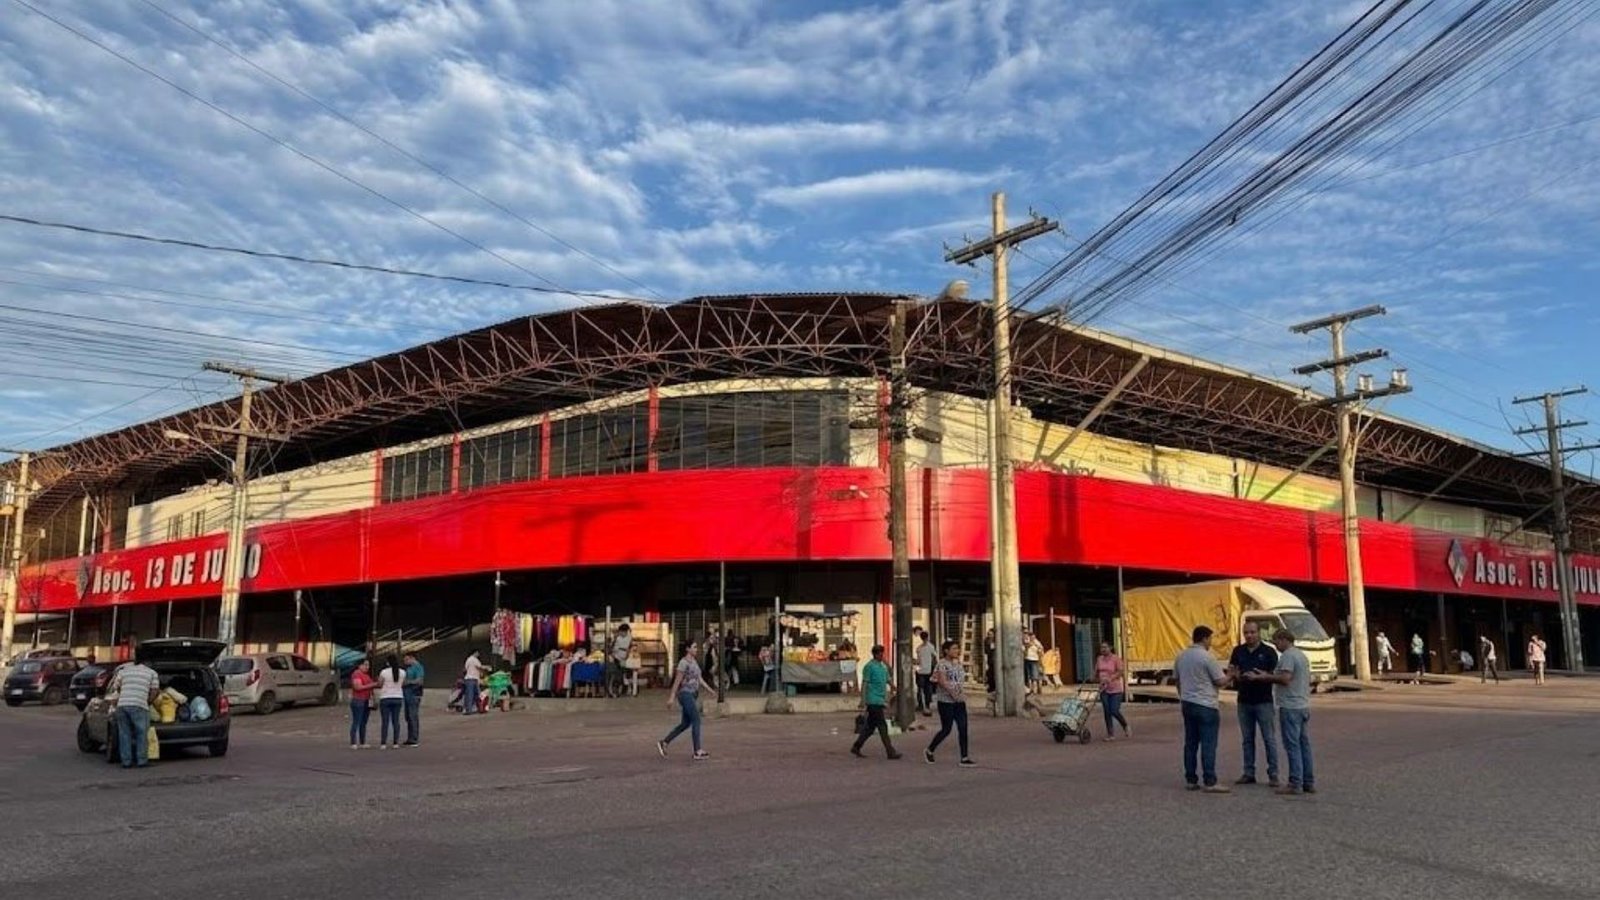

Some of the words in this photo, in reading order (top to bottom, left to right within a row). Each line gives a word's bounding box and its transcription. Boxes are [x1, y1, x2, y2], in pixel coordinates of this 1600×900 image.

[146, 558, 166, 589] 13
[171, 554, 196, 586] DE
[202, 545, 261, 583] JUIO
[1531, 560, 1548, 589] 13
